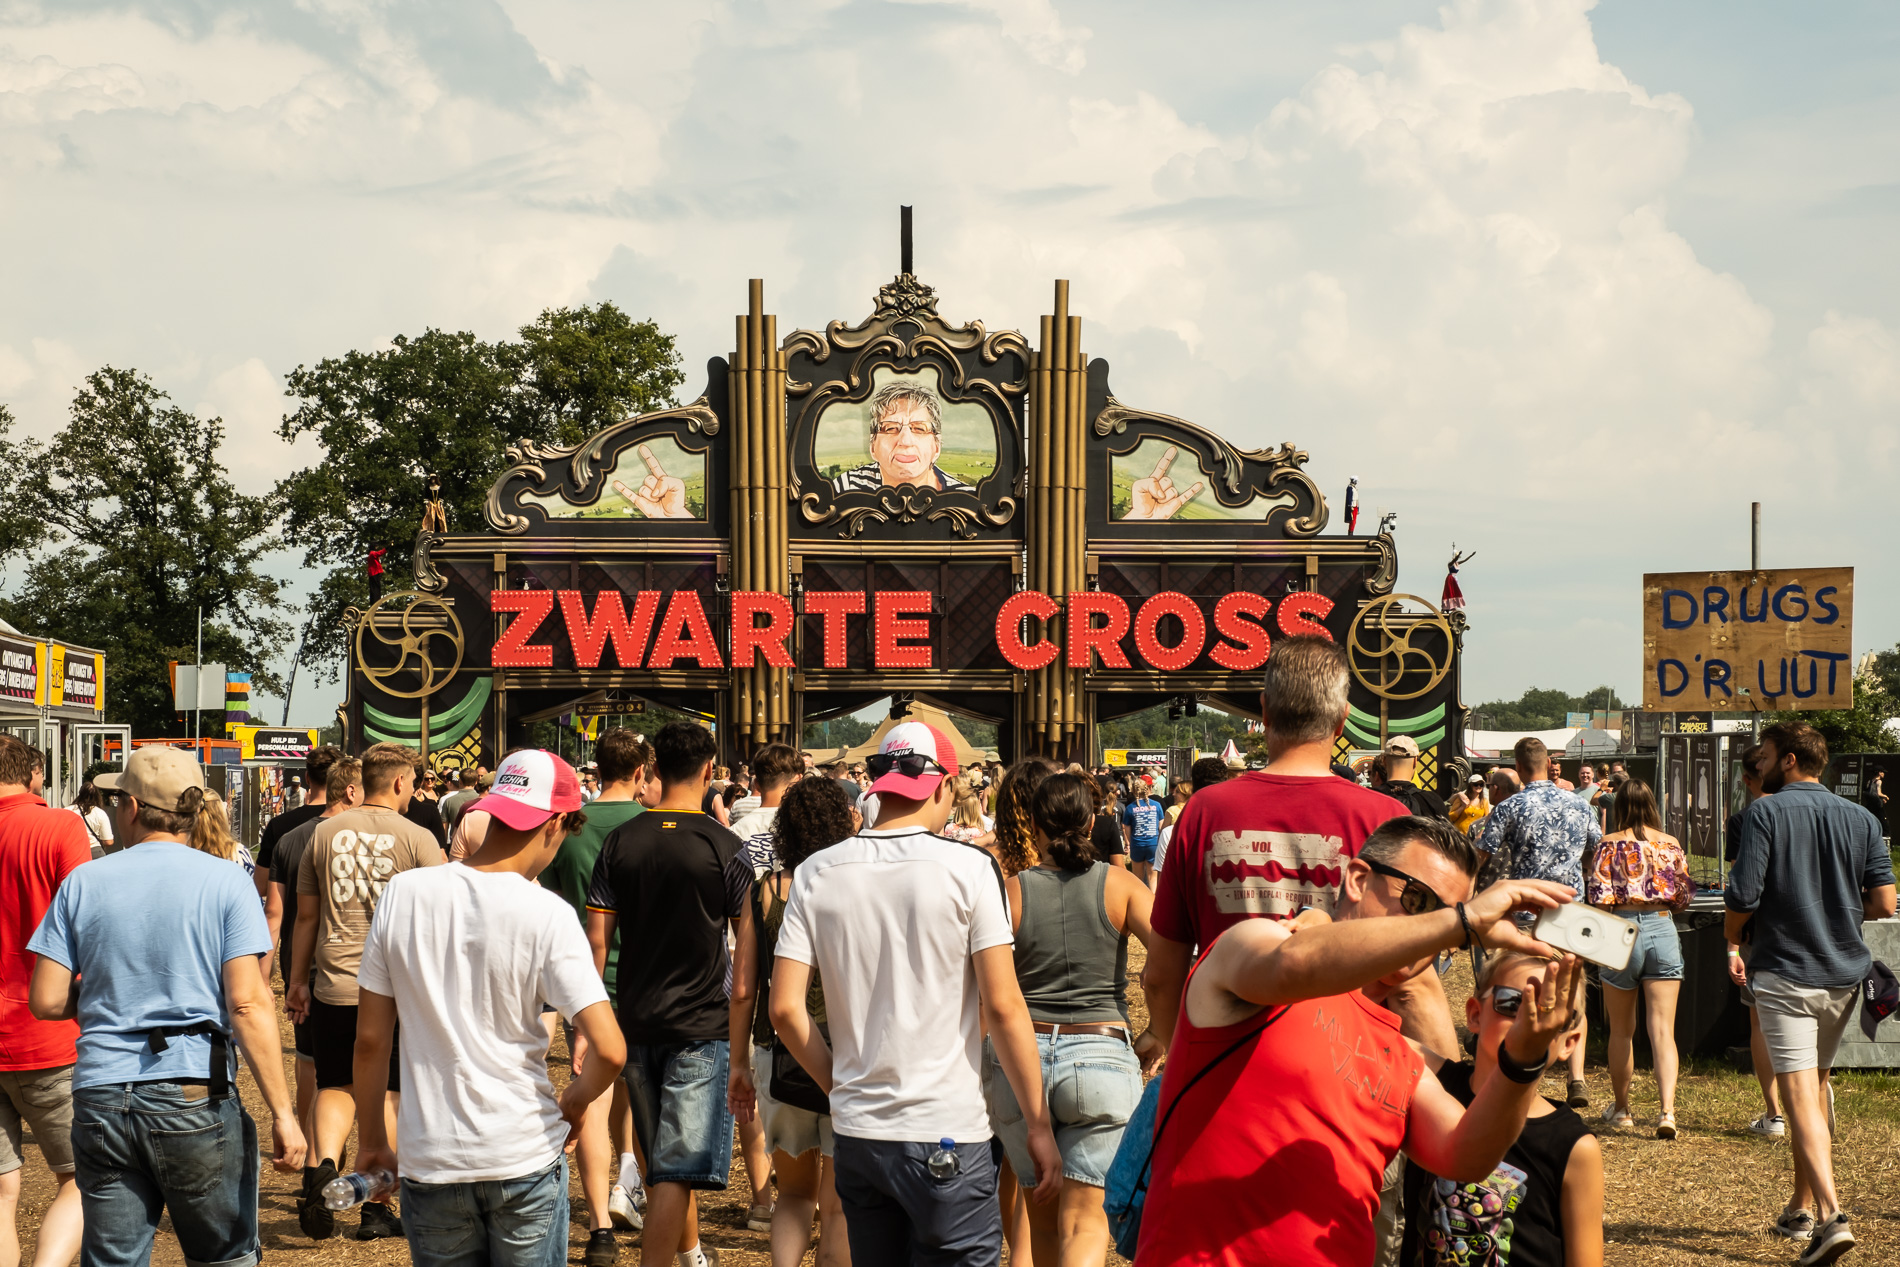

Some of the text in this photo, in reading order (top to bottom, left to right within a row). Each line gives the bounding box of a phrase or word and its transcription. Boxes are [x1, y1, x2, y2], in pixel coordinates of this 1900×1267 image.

[1662, 584, 1839, 630] DRUGS
[490, 590, 1336, 671] ZWARTE CROSS
[1657, 650, 1850, 701] D'R UUT
[500, 775, 527, 786] SCHIK
[332, 829, 396, 856] OTP
[1252, 842, 1272, 852] VOL
[331, 853, 394, 880] OTP
[1259, 890, 1282, 899] REPLAY
[1285, 893, 1313, 905] REBOUND
